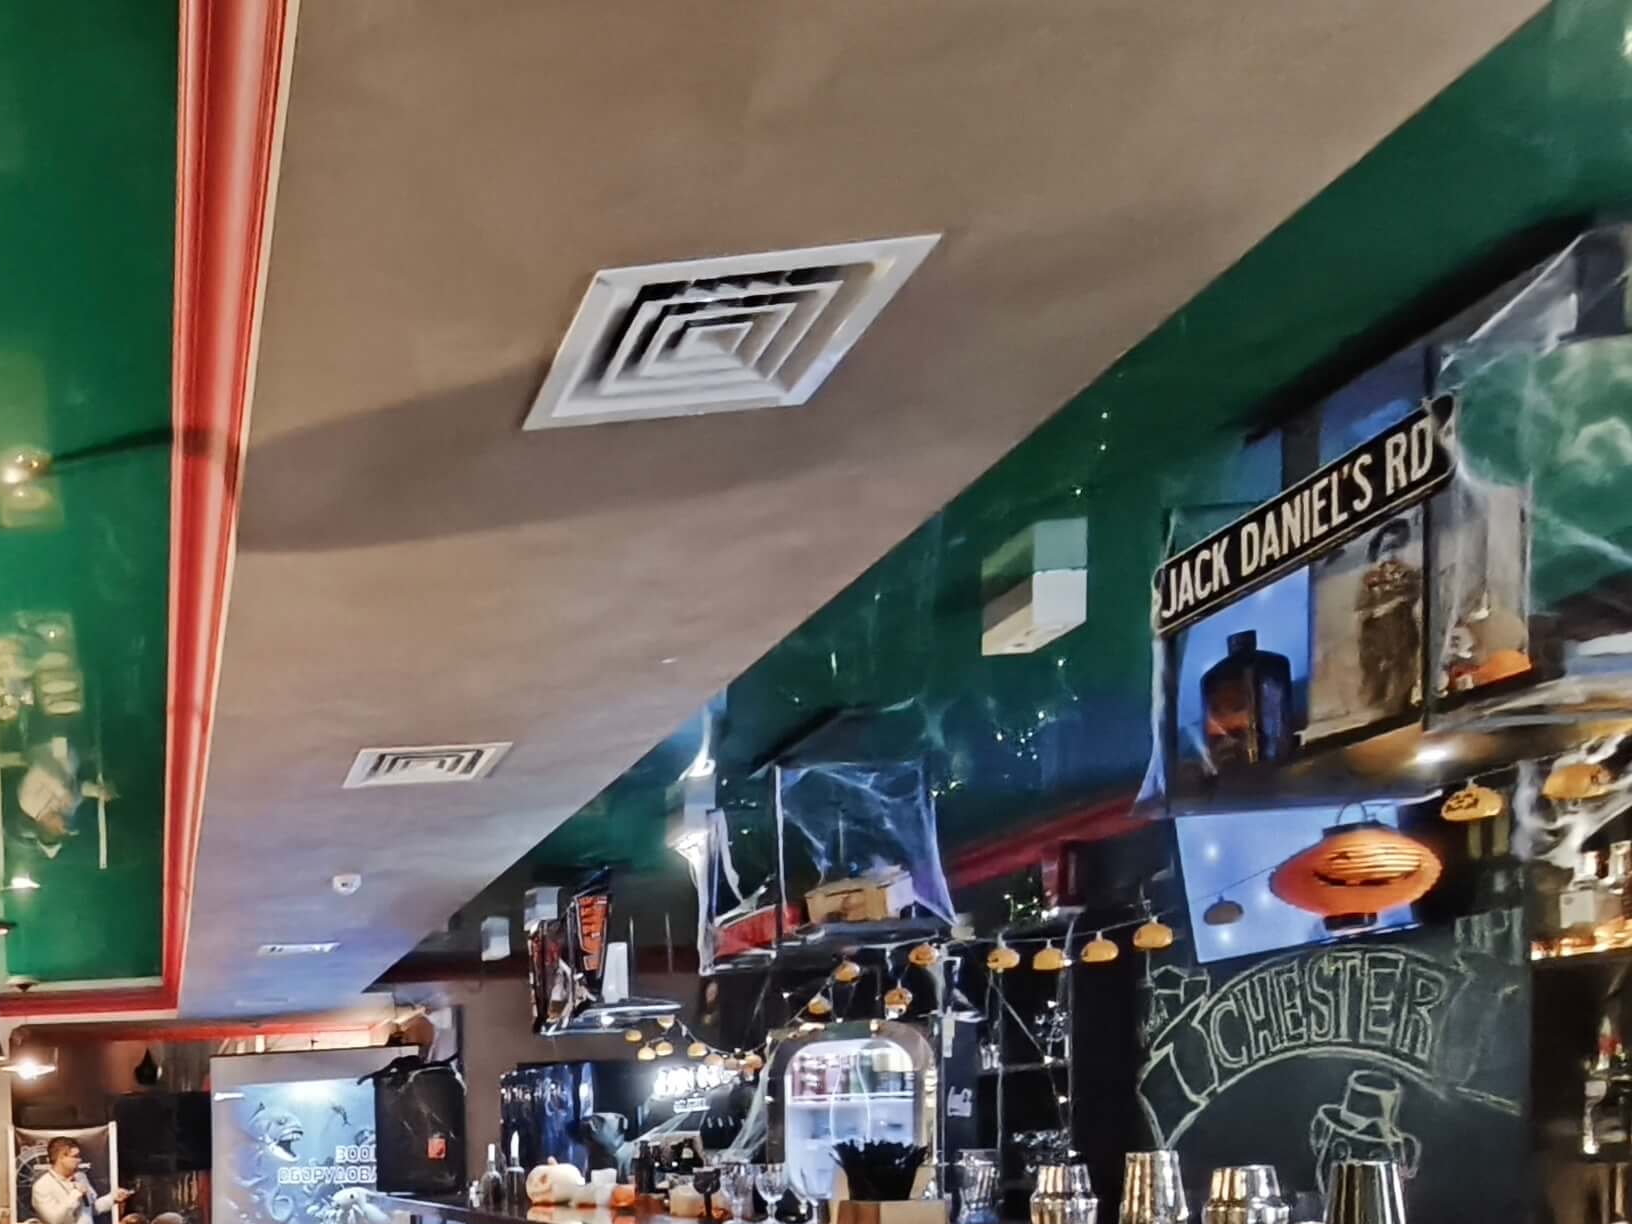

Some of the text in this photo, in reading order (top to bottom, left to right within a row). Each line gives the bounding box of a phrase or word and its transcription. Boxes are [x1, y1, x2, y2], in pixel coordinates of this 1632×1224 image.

[1161, 417, 1434, 619] JACK DANIEL'S RD
[1209, 952, 1447, 1069] CHESTER
